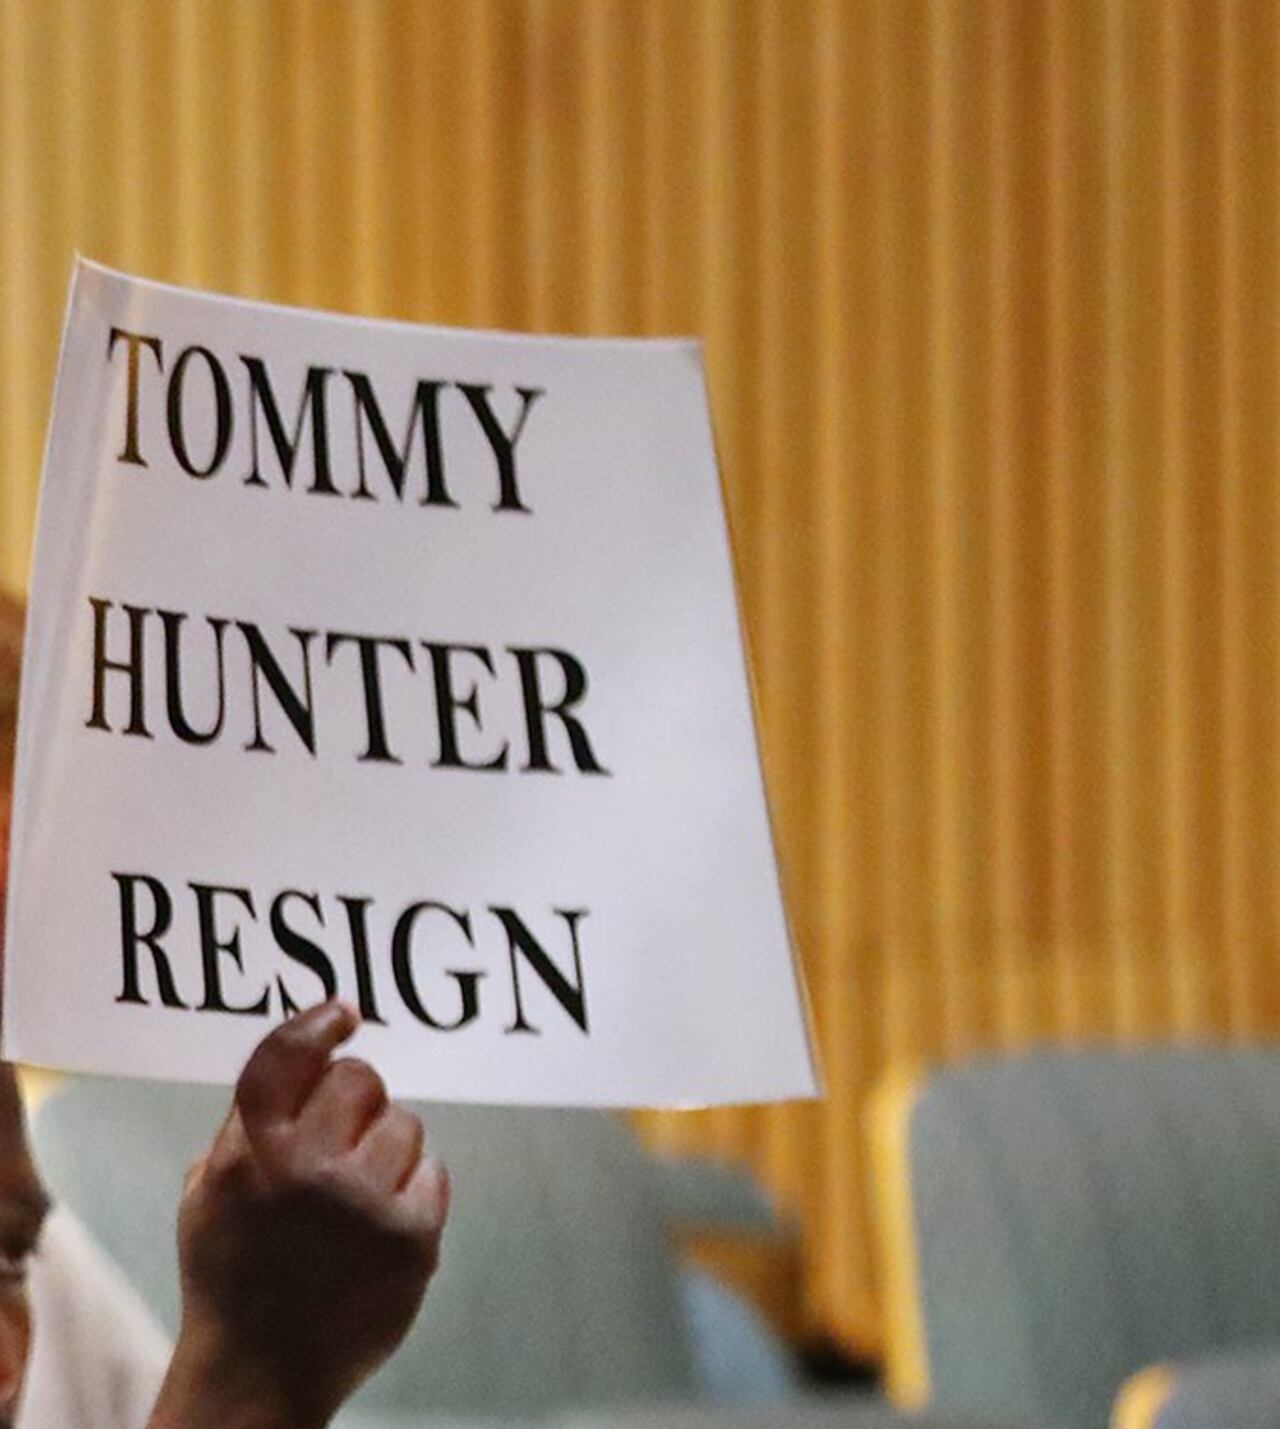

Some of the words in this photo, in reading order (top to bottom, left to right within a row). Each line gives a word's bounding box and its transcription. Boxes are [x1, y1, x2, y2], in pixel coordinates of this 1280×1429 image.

[107, 325, 546, 515] TOMMY
[83, 595, 612, 777] HUNTER
[109, 870, 591, 1038] RESIGN
